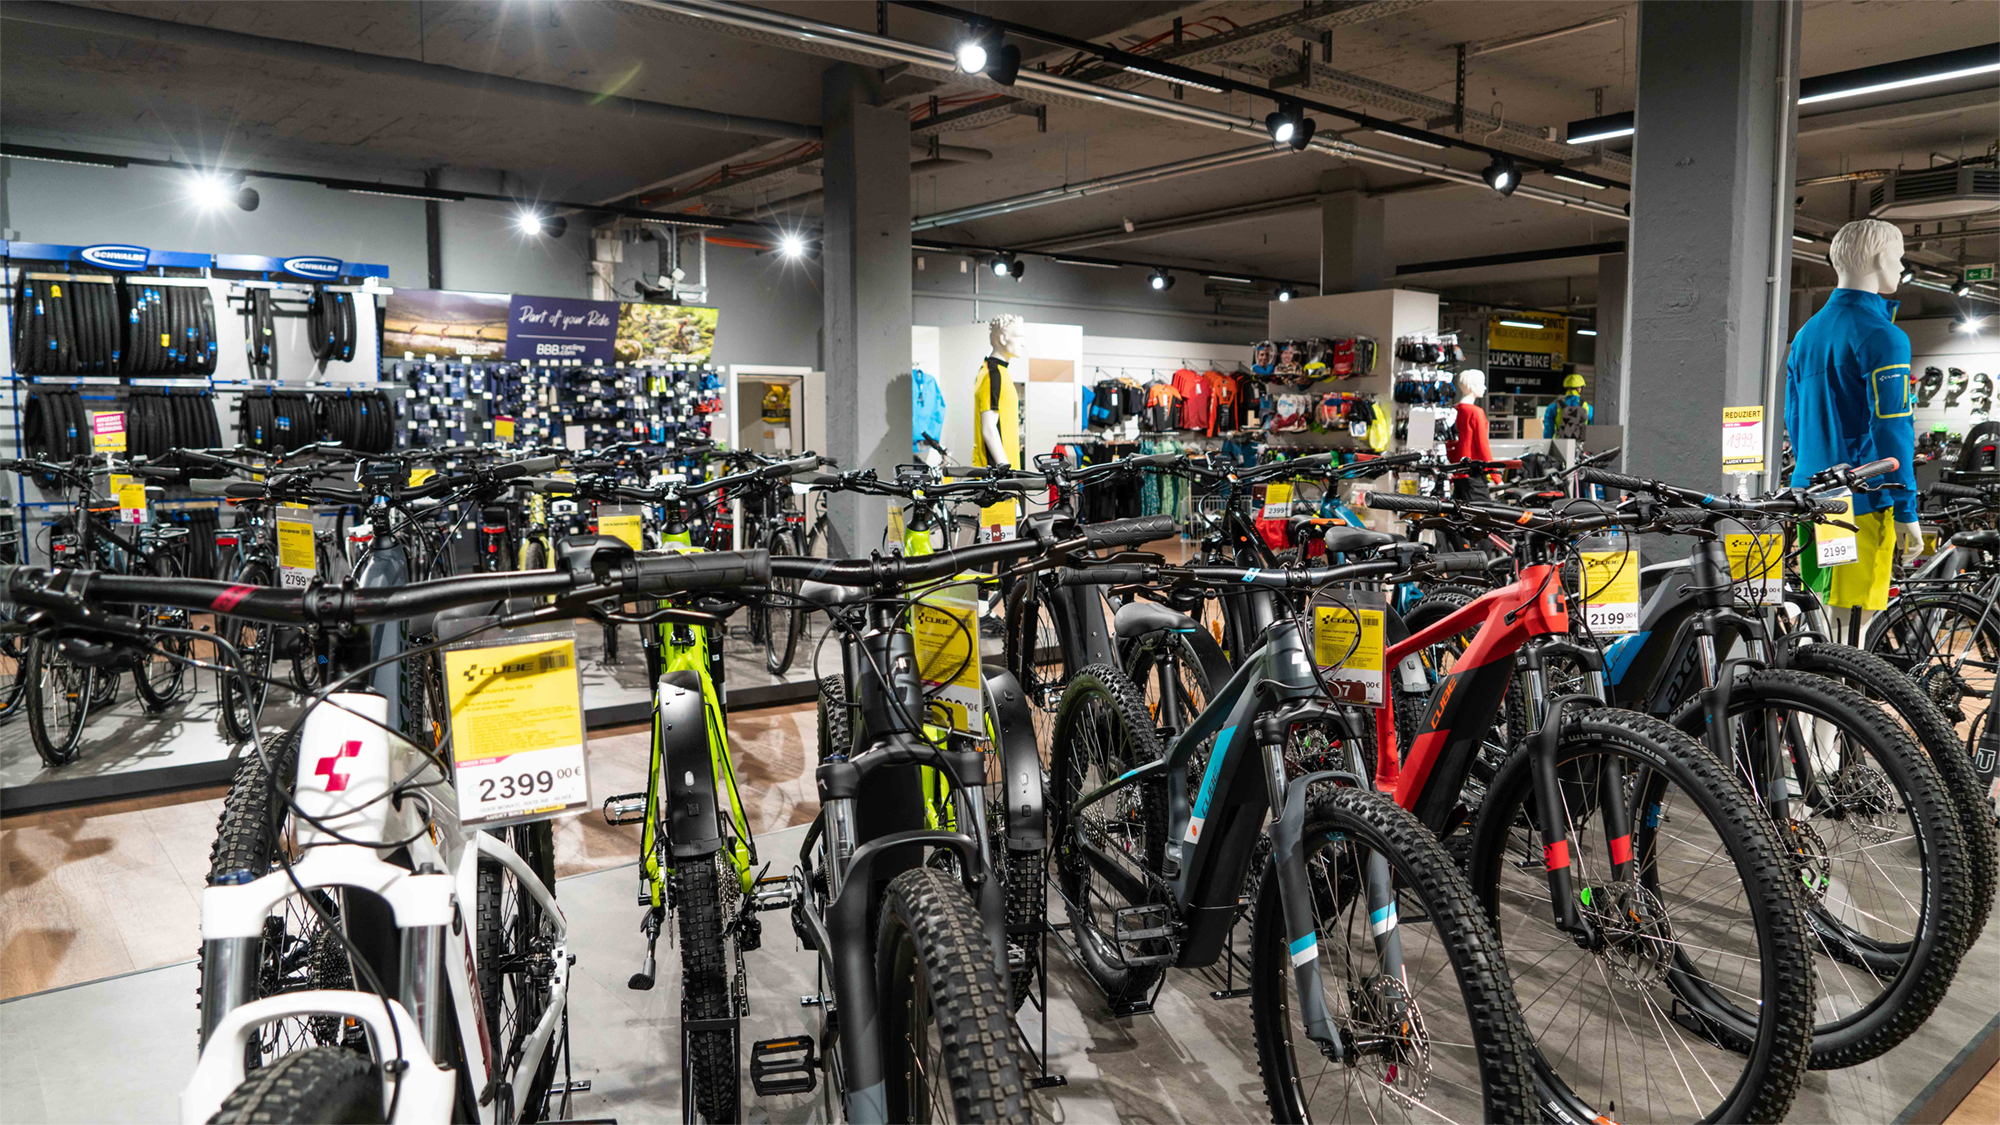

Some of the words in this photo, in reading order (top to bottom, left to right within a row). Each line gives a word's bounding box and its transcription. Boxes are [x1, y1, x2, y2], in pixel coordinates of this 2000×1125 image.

[94, 251, 147, 262] SCHWALBE
[294, 262, 339, 273] SCHWALBE
[519, 305, 548, 324] Part
[549, 309, 562, 328] of
[562, 315, 586, 331] your
[587, 310, 610, 327] Ride
[536, 343, 560, 355] BBB
[1488, 351, 1522, 367] LUCKY
[1524, 354, 1550, 368] BIKE
[1725, 410, 1761, 419] REDUZIERT
[1824, 545, 1847, 558] 2199
[284, 574, 307, 587] 2799
[924, 616, 953, 626] CUBE
[1591, 612, 1625, 626] 2199
[480, 662, 534, 676] CUBE
[486, 686, 504, 694] Hybrid
[1431, 675, 1458, 730] CUBE
[479, 770, 553, 802] 2399
[556, 768, 572, 779] 00
[575, 766, 582, 776] €
[1201, 765, 1220, 817] CUBE
